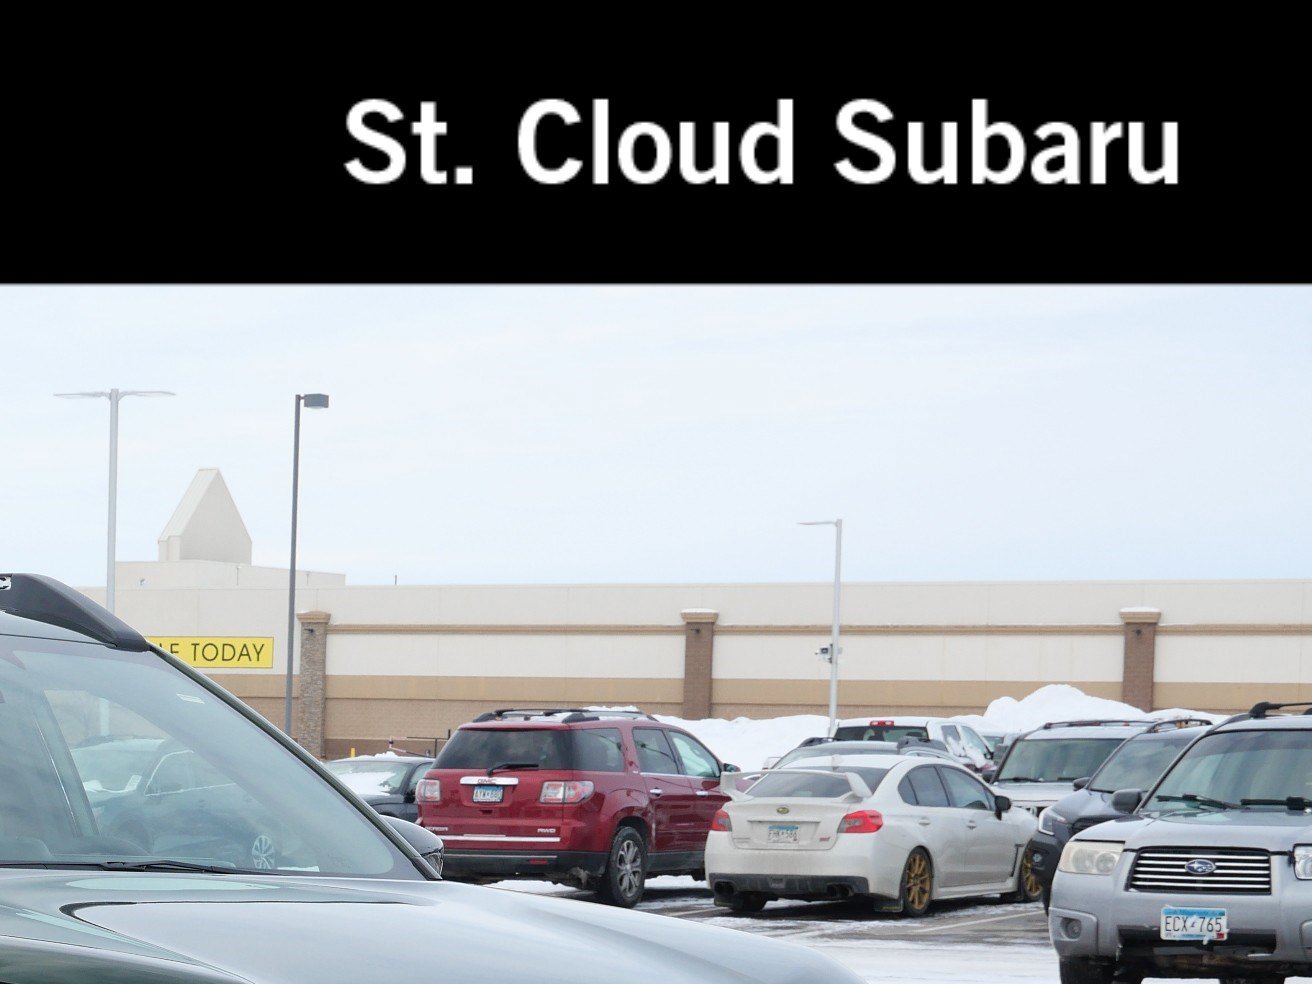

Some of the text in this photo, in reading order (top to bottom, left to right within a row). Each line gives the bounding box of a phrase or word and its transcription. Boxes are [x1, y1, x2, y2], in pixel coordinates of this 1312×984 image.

[191, 642, 265, 662] TODAY
[1165, 916, 1222, 933] ECX 765
